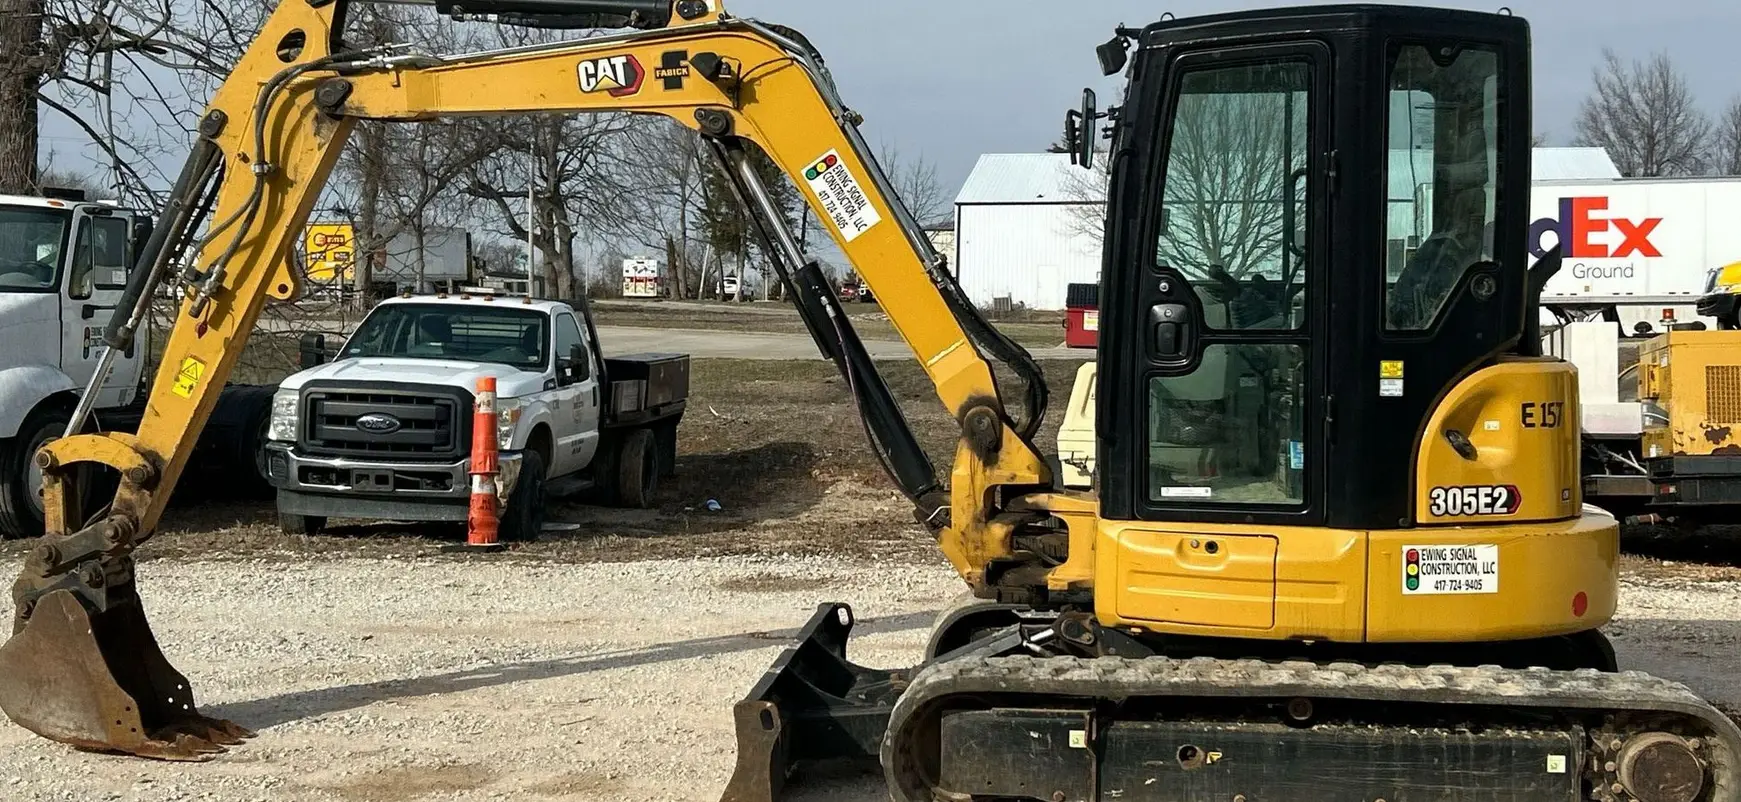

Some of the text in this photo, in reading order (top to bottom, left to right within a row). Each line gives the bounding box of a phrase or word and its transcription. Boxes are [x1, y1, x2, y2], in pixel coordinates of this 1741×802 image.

[577, 55, 627, 92] CAT
[655, 67, 688, 78] FABICK
[822, 171, 868, 231] CONSTRUCTION, LLC
[832, 164, 867, 211] EWING SIGNAL
[1529, 196, 1664, 258] dEx
[1572, 263, 1634, 279] Ground
[1521, 401, 1565, 428] E 157
[1430, 486, 1508, 515] 305E2
[1421, 548, 1477, 561] EWING SIGNAL
[1421, 561, 1495, 576] CONSTRUCTION, LLC
